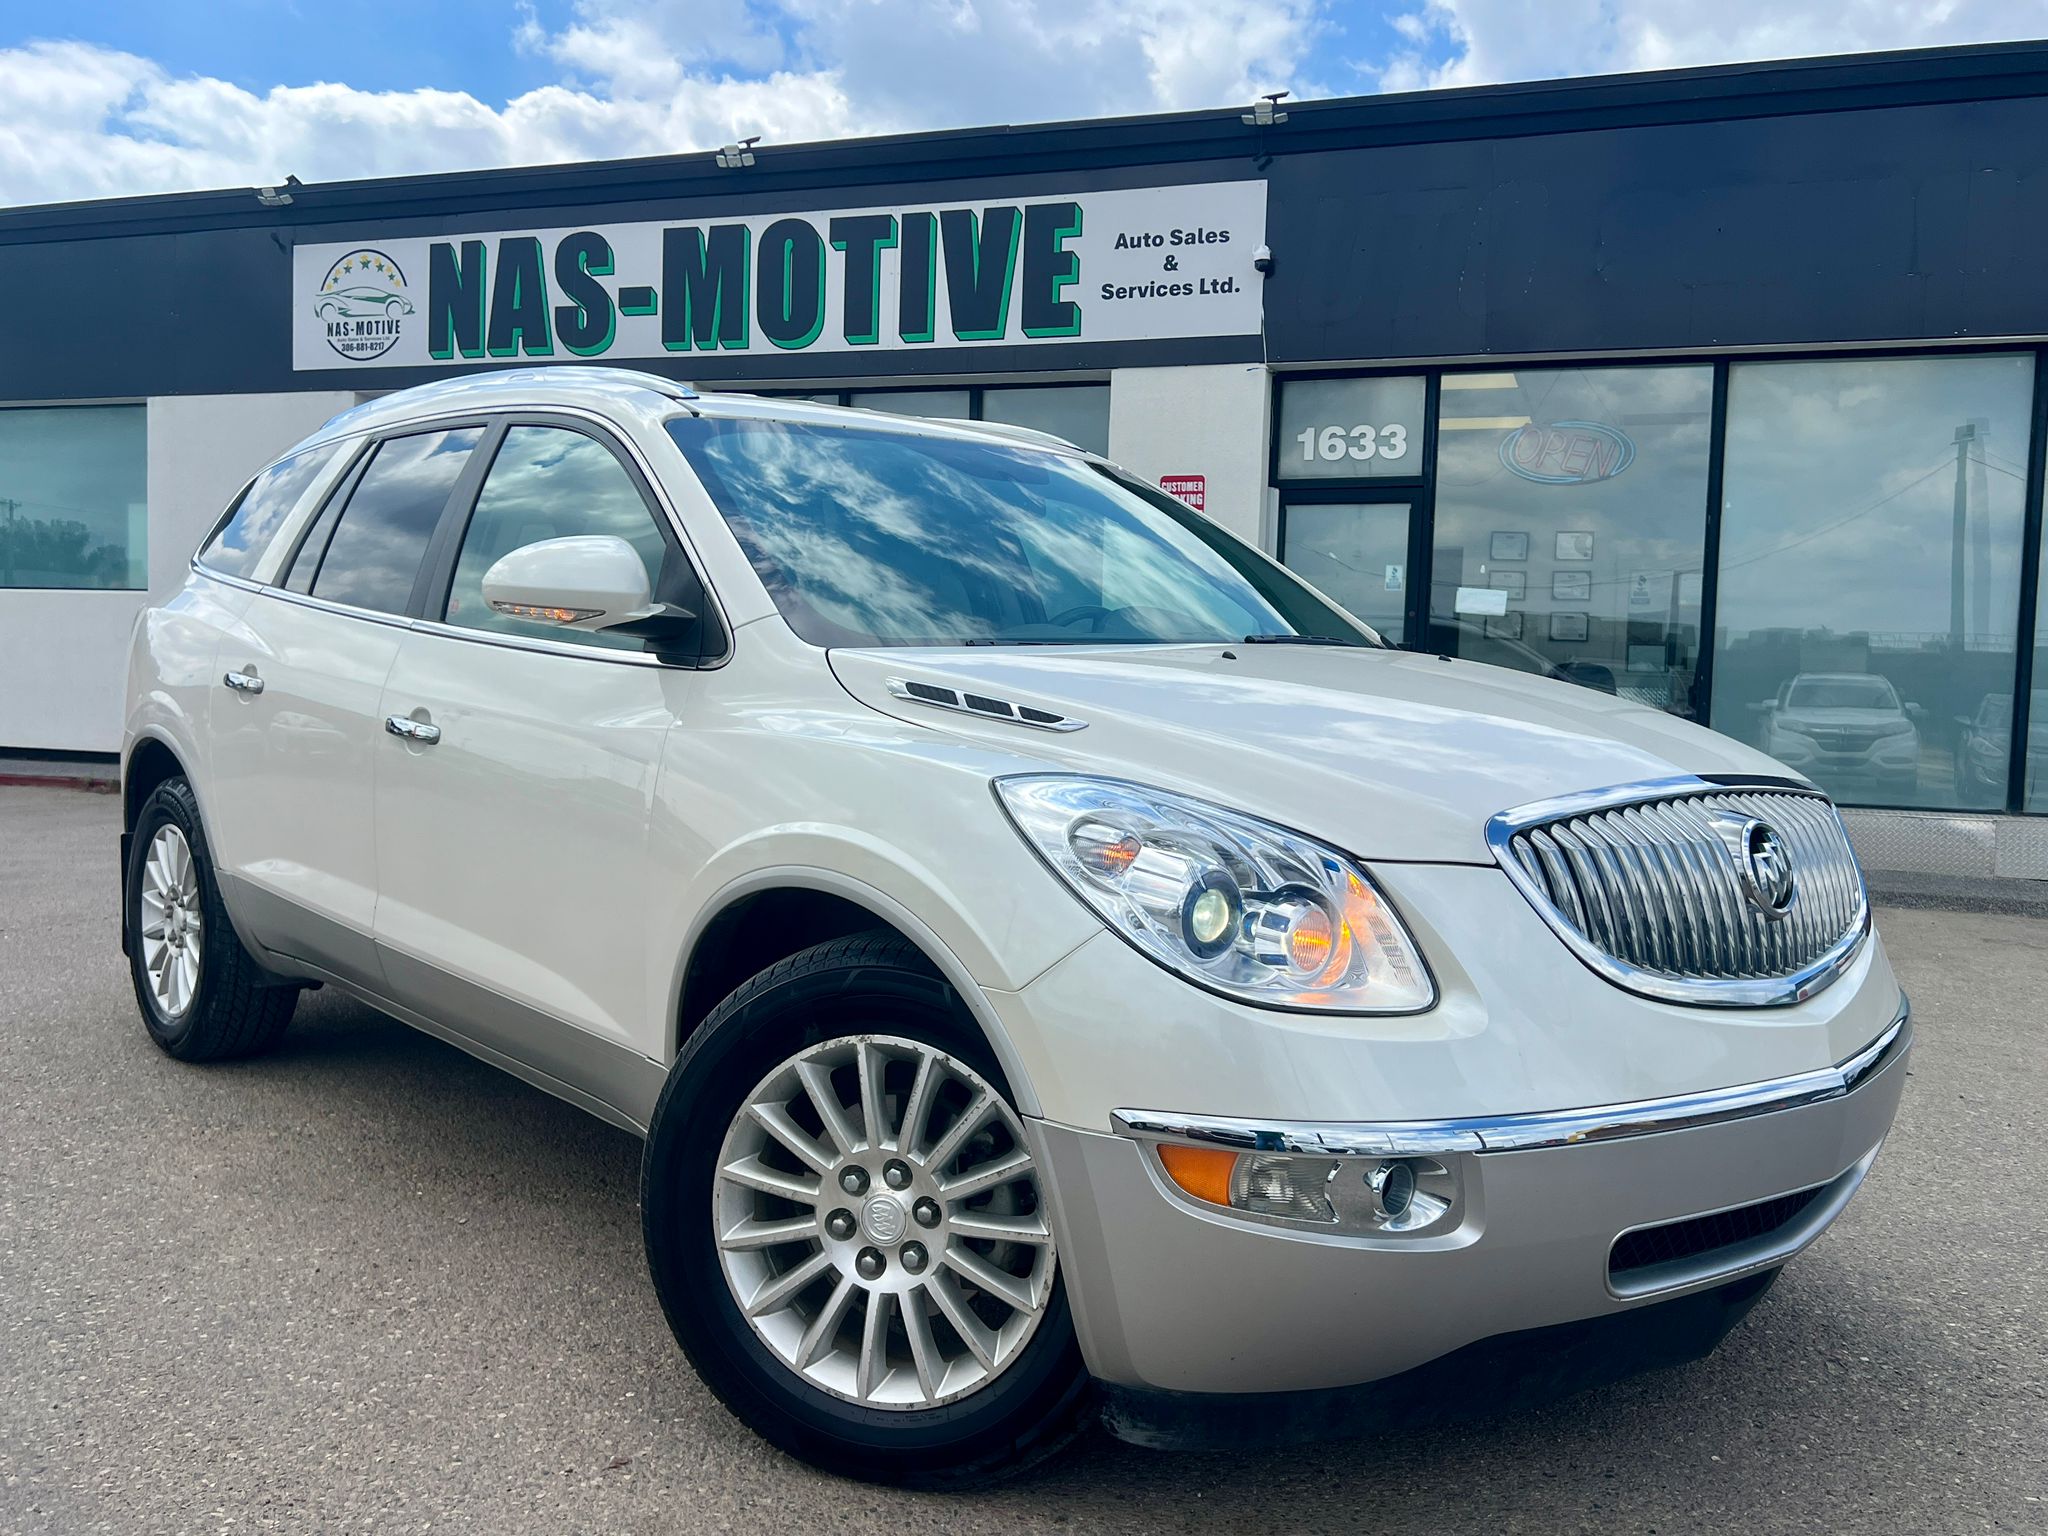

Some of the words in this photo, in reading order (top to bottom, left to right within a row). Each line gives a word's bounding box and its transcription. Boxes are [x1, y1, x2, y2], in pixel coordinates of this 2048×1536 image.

[1114, 233, 1164, 250] Auto
[1169, 228, 1230, 246] Sales
[1163, 254, 1179, 271] &
[428, 202, 1083, 360] NAS-MOTIVE
[1101, 281, 1194, 300] Services
[1199, 277, 1241, 295] Ltd.
[327, 320, 400, 337] NAS-MOTIVE
[1297, 423, 1407, 461] 1633
[1515, 427, 1617, 479] OPEN
[1161, 481, 1204, 492] CUSTOMER
